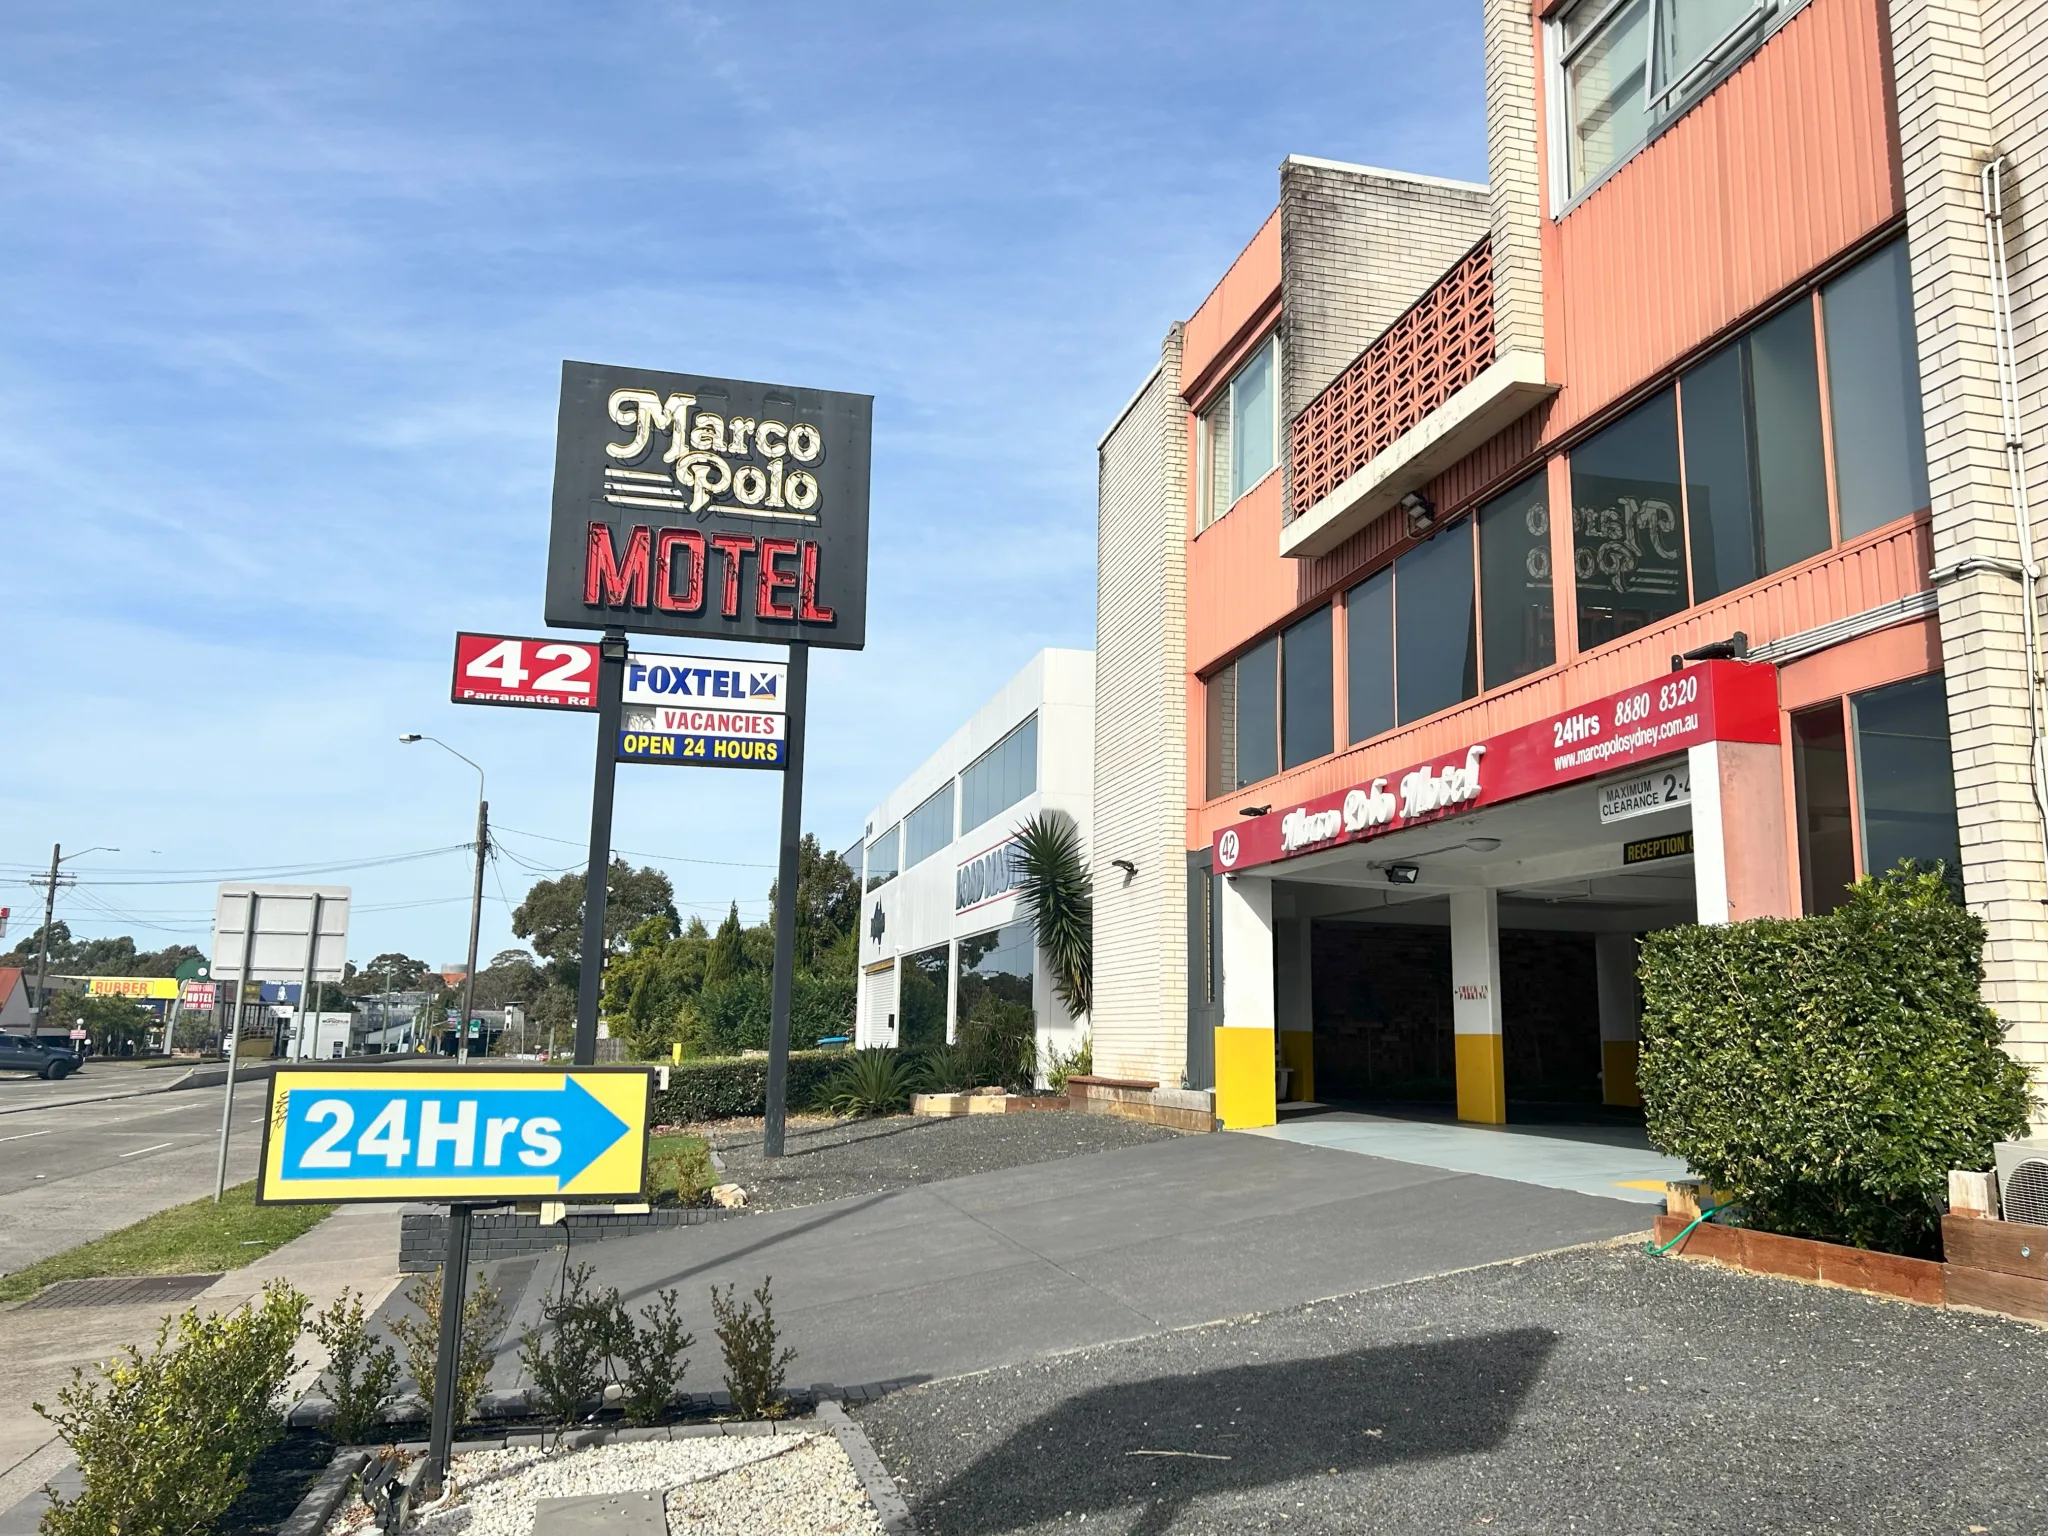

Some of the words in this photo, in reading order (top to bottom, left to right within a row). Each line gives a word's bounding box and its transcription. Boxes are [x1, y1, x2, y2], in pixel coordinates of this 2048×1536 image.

[605, 388, 821, 463] Marco
[675, 451, 818, 513] Polo
[583, 520, 834, 622] MOTEL
[466, 640, 592, 693] 42
[628, 665, 746, 699] FOXTEL
[463, 689, 560, 705] Parramatta
[568, 695, 589, 706] Rd
[1553, 714, 1600, 748] 24Hrs
[1614, 692, 1650, 727] 8880
[1659, 676, 1698, 712] 8320
[663, 711, 775, 735] VACANCIES
[623, 734, 674, 755] OPEN
[683, 738, 706, 757] 24
[714, 740, 778, 761] HOURS
[1554, 713, 1698, 771] www.marcopolosydney.com.au
[1602, 792, 1660, 817] CLEARANCE
[1606, 780, 1652, 803] MAXIMUM
[1222, 834, 1235, 860] 42
[1628, 835, 1685, 861] RECEPTION
[95, 981, 148, 994] RUBBER
[299, 1098, 563, 1168] 24Hrs
